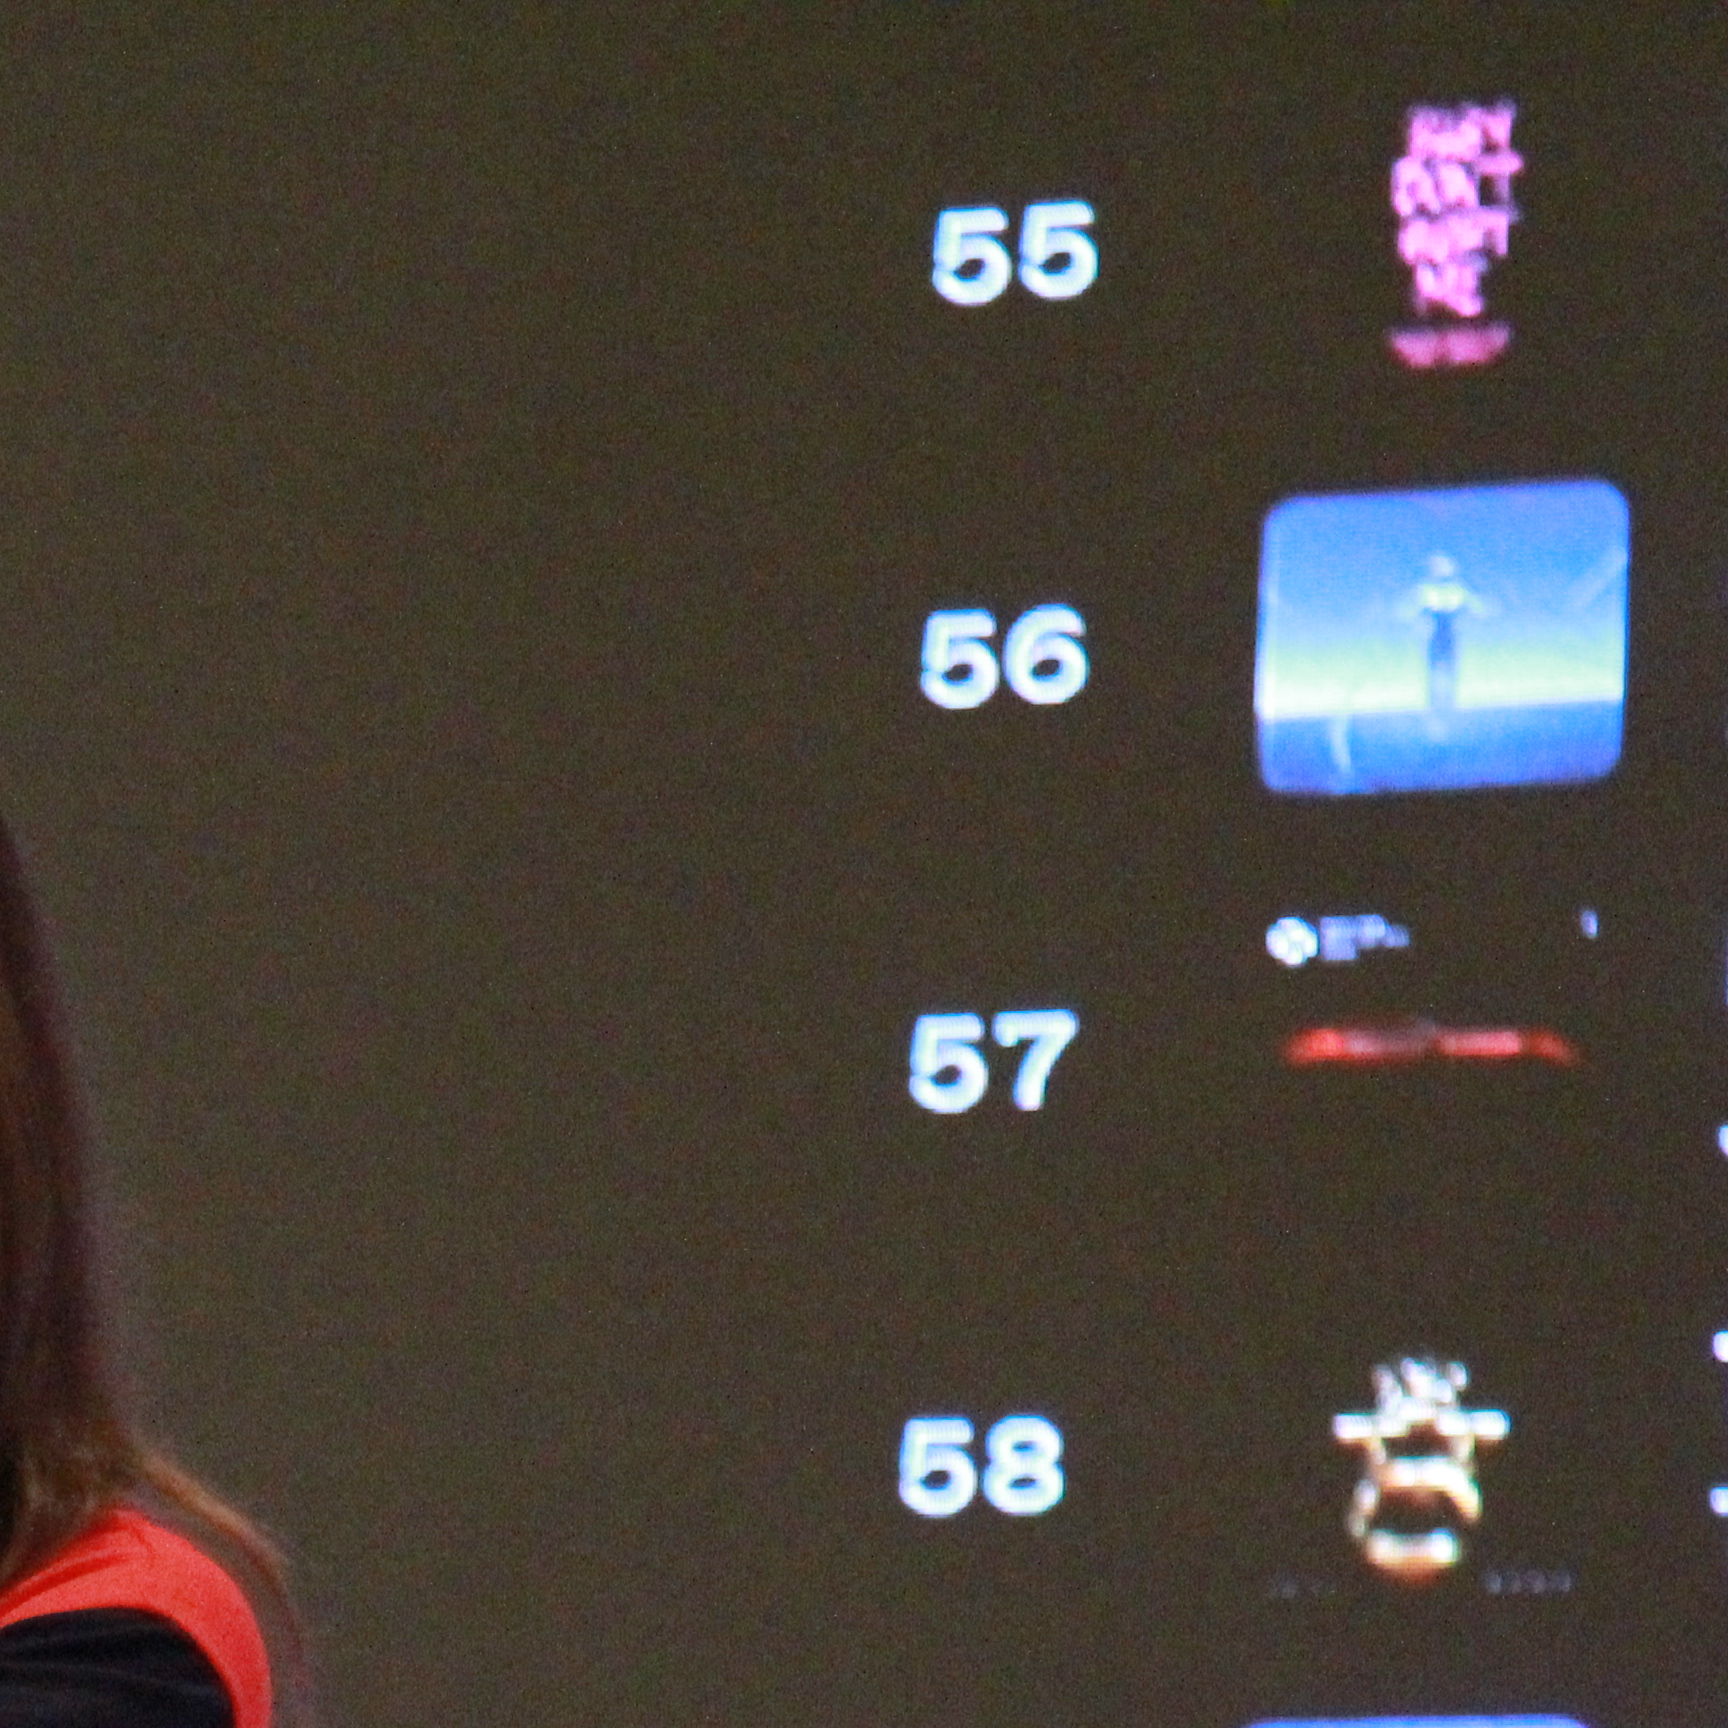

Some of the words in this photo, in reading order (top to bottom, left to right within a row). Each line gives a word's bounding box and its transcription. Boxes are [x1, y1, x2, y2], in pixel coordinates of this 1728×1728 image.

[932, 200, 1098, 306] 55
[920, 604, 1090, 709] 56
[909, 1009, 1080, 1114] 57
[898, 1415, 1064, 1518] 58
